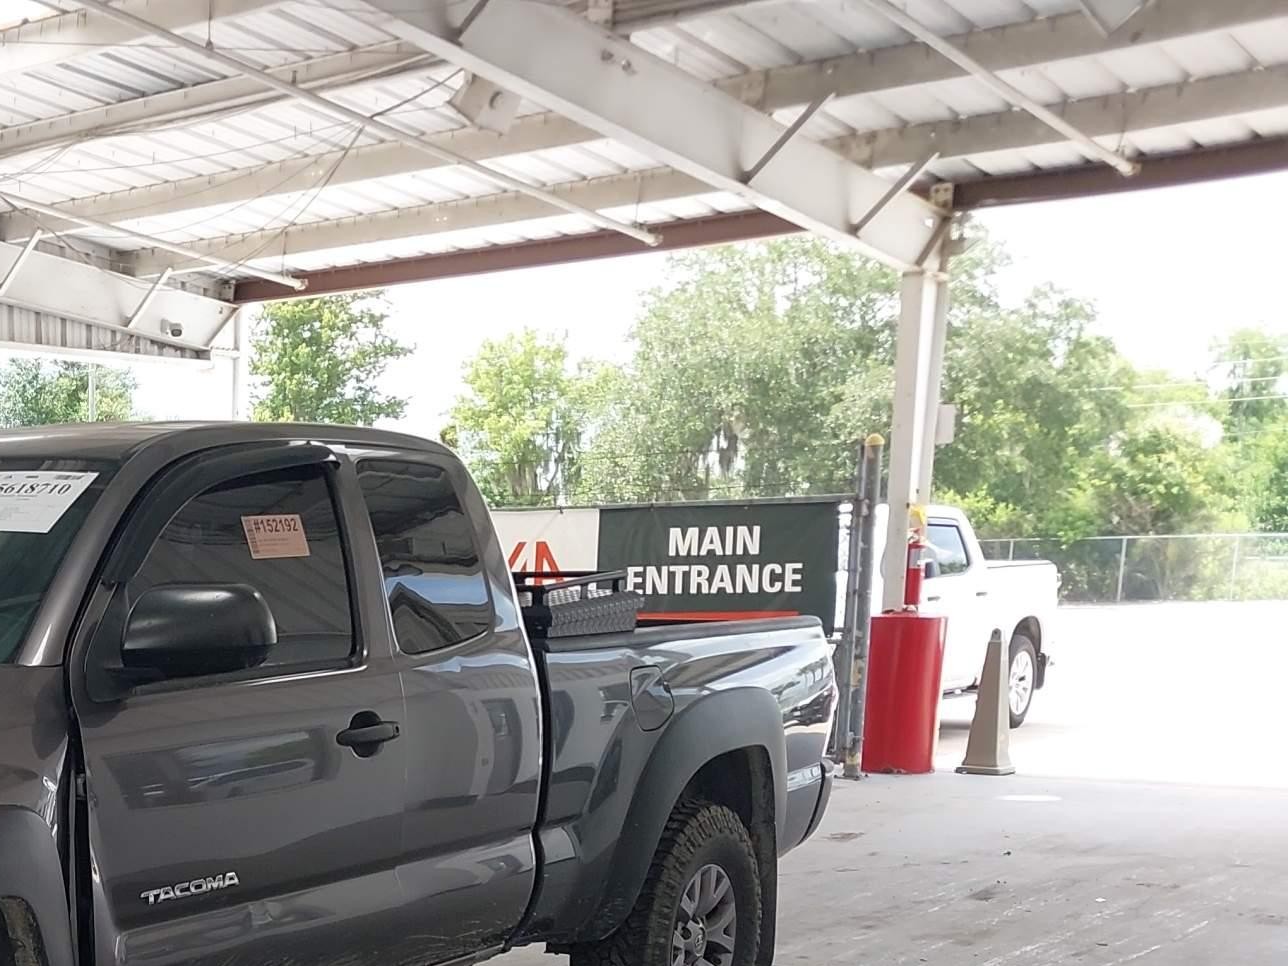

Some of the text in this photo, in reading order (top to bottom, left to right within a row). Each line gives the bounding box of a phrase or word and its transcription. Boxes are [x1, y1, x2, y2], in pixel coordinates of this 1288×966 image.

[253, 518, 299, 533] #152192
[668, 525, 761, 556] MAIN
[626, 562, 803, 595] ENTRANCE
[140, 871, 240, 905] TACOMA
